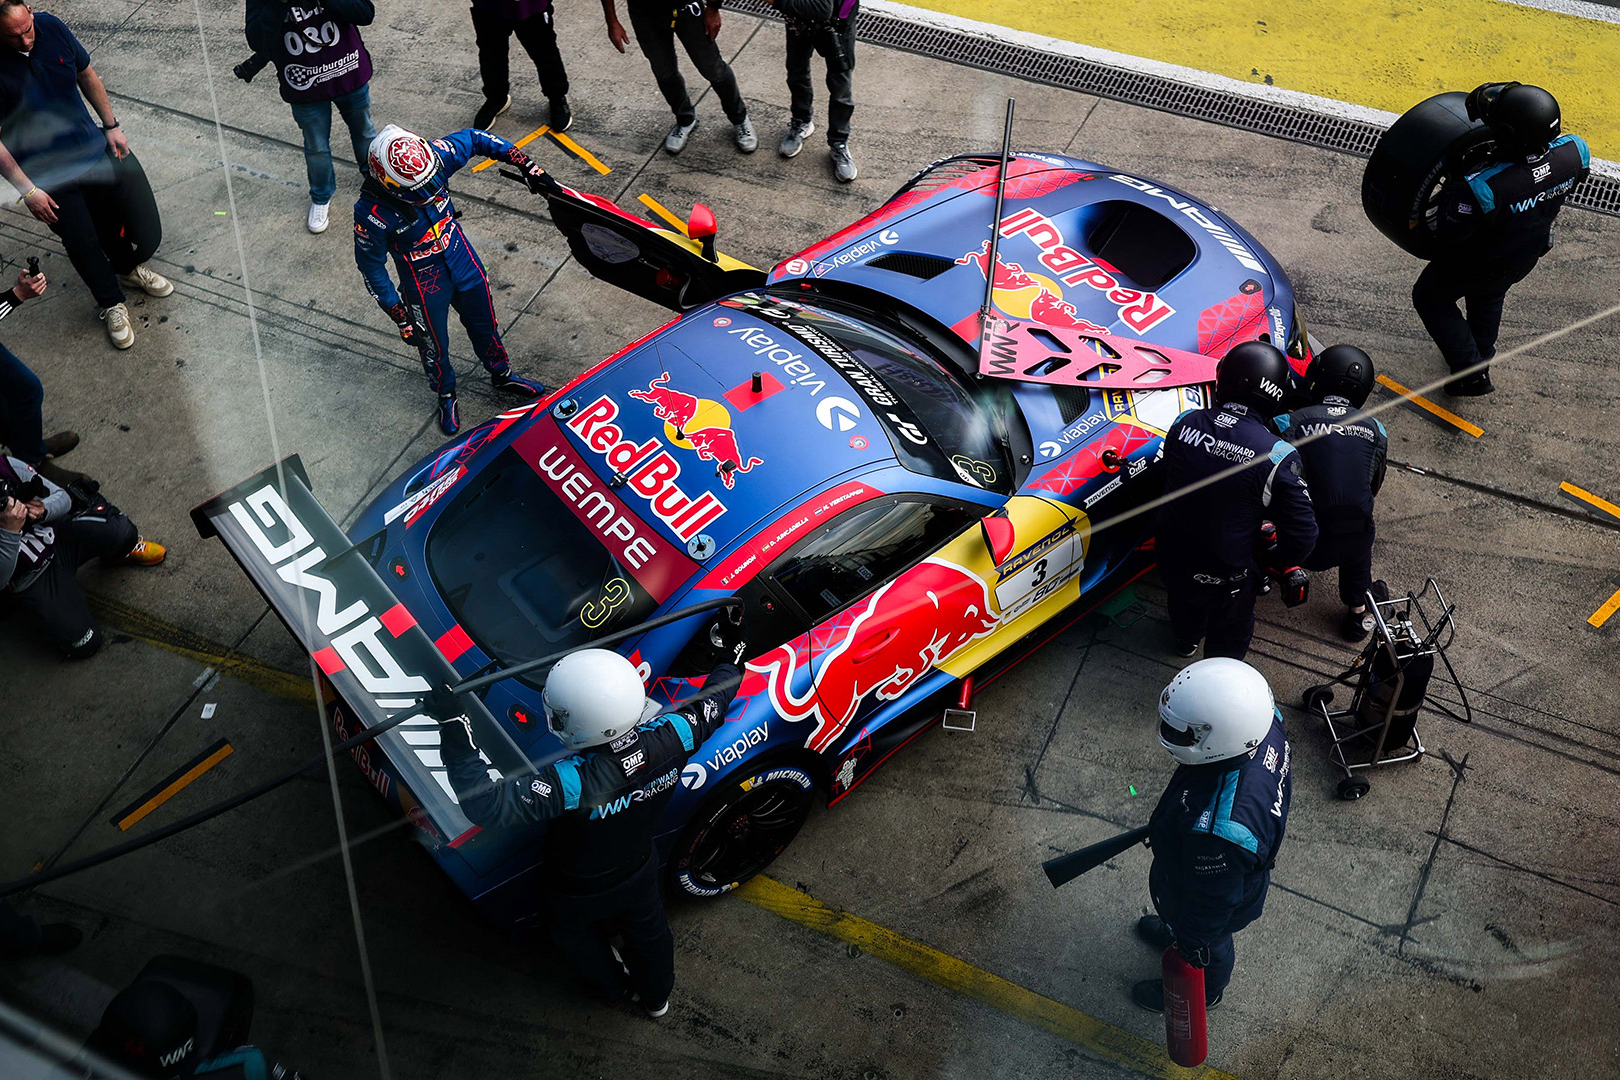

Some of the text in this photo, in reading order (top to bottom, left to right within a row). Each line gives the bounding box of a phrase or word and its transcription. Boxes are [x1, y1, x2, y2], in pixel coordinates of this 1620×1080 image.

[1532, 164, 1551, 179] OMP
[833, 240, 882, 269] viaplay
[727, 326, 826, 397] viaplay
[787, 323, 856, 374] TURISMO
[846, 370, 893, 407] GRAN
[1058, 410, 1107, 444] viaplay
[1216, 414, 1238, 426] OMP
[1213, 447, 1252, 466] RACING
[1217, 440, 1256, 458] WINWARD
[566, 394, 729, 544] Red Bull
[829, 488, 864, 508] VERSTAPPEN
[1088, 480, 1121, 504] RAVENOL
[538, 445, 657, 570] WEMPE
[776, 516, 809, 543] JUNCADELLA
[1003, 526, 1070, 575] RAVENOL
[1031, 558, 1049, 588] 3
[228, 484, 433, 693] AMG
[580, 577, 631, 629] 3
[706, 720, 770, 772] viaplay
[1265, 746, 1277, 771] OMP
[622, 752, 645, 770] OMP
[531, 781, 552, 797] OMP
[644, 774, 679, 800] RACING
[765, 770, 812, 791] MICHELIN
[679, 872, 720, 897] MICHELIN
